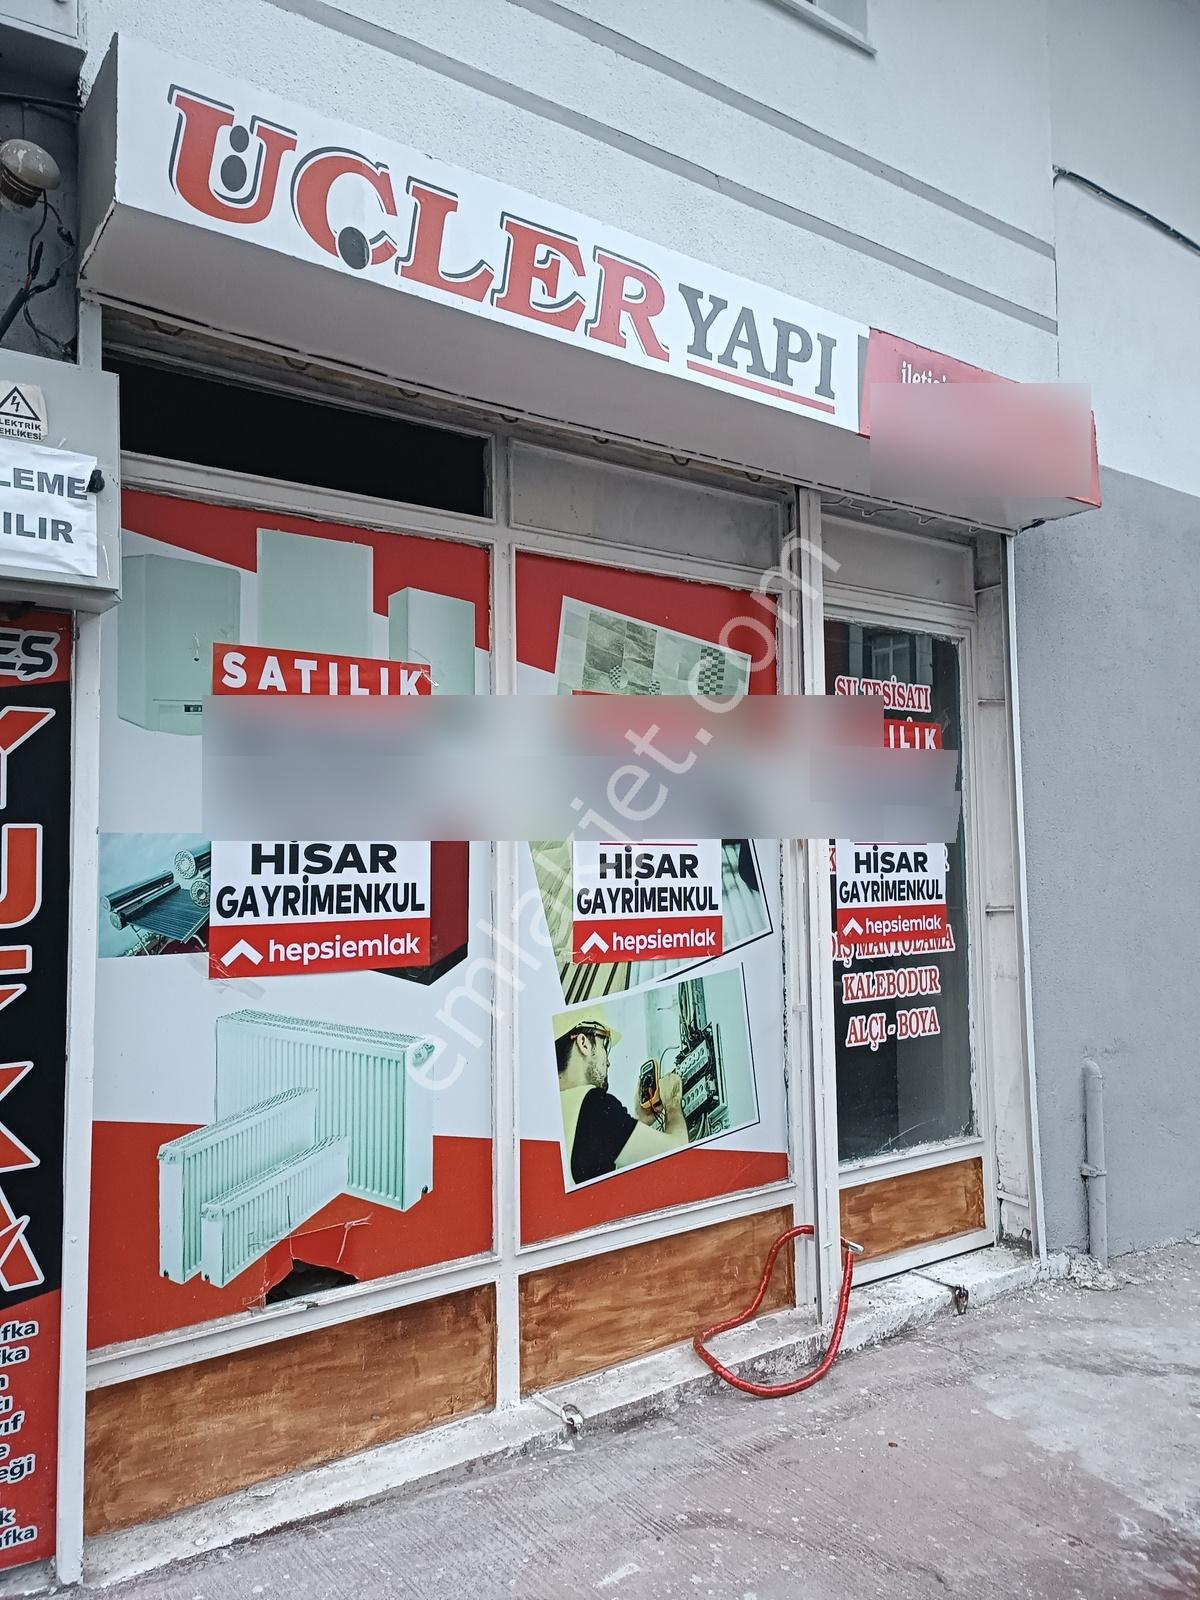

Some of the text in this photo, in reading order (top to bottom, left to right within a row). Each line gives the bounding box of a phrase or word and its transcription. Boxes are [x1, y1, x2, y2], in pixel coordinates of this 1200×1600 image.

[678, 282, 837, 400] YAPI
[3, 511, 74, 544] ILIR
[221, 651, 421, 695] SATILIK
[250, 841, 398, 876] HİSAR
[599, 845, 699, 880] HİSAR
[853, 844, 928, 874] HİSAR
[215, 874, 426, 919] GAYRİMENKUL
[576, 878, 719, 915] GAYRİMENKUL
[838, 873, 944, 904] GAYRİMENKUL
[612, 927, 717, 954] hepsiemlak
[865, 914, 942, 937] hepsiemlak
[268, 931, 421, 967] hepsiemlak
[842, 967, 940, 1002] KALEBODUR
[846, 1014, 886, 1048] ALÇI
[897, 1007, 940, 1036] BOYA
